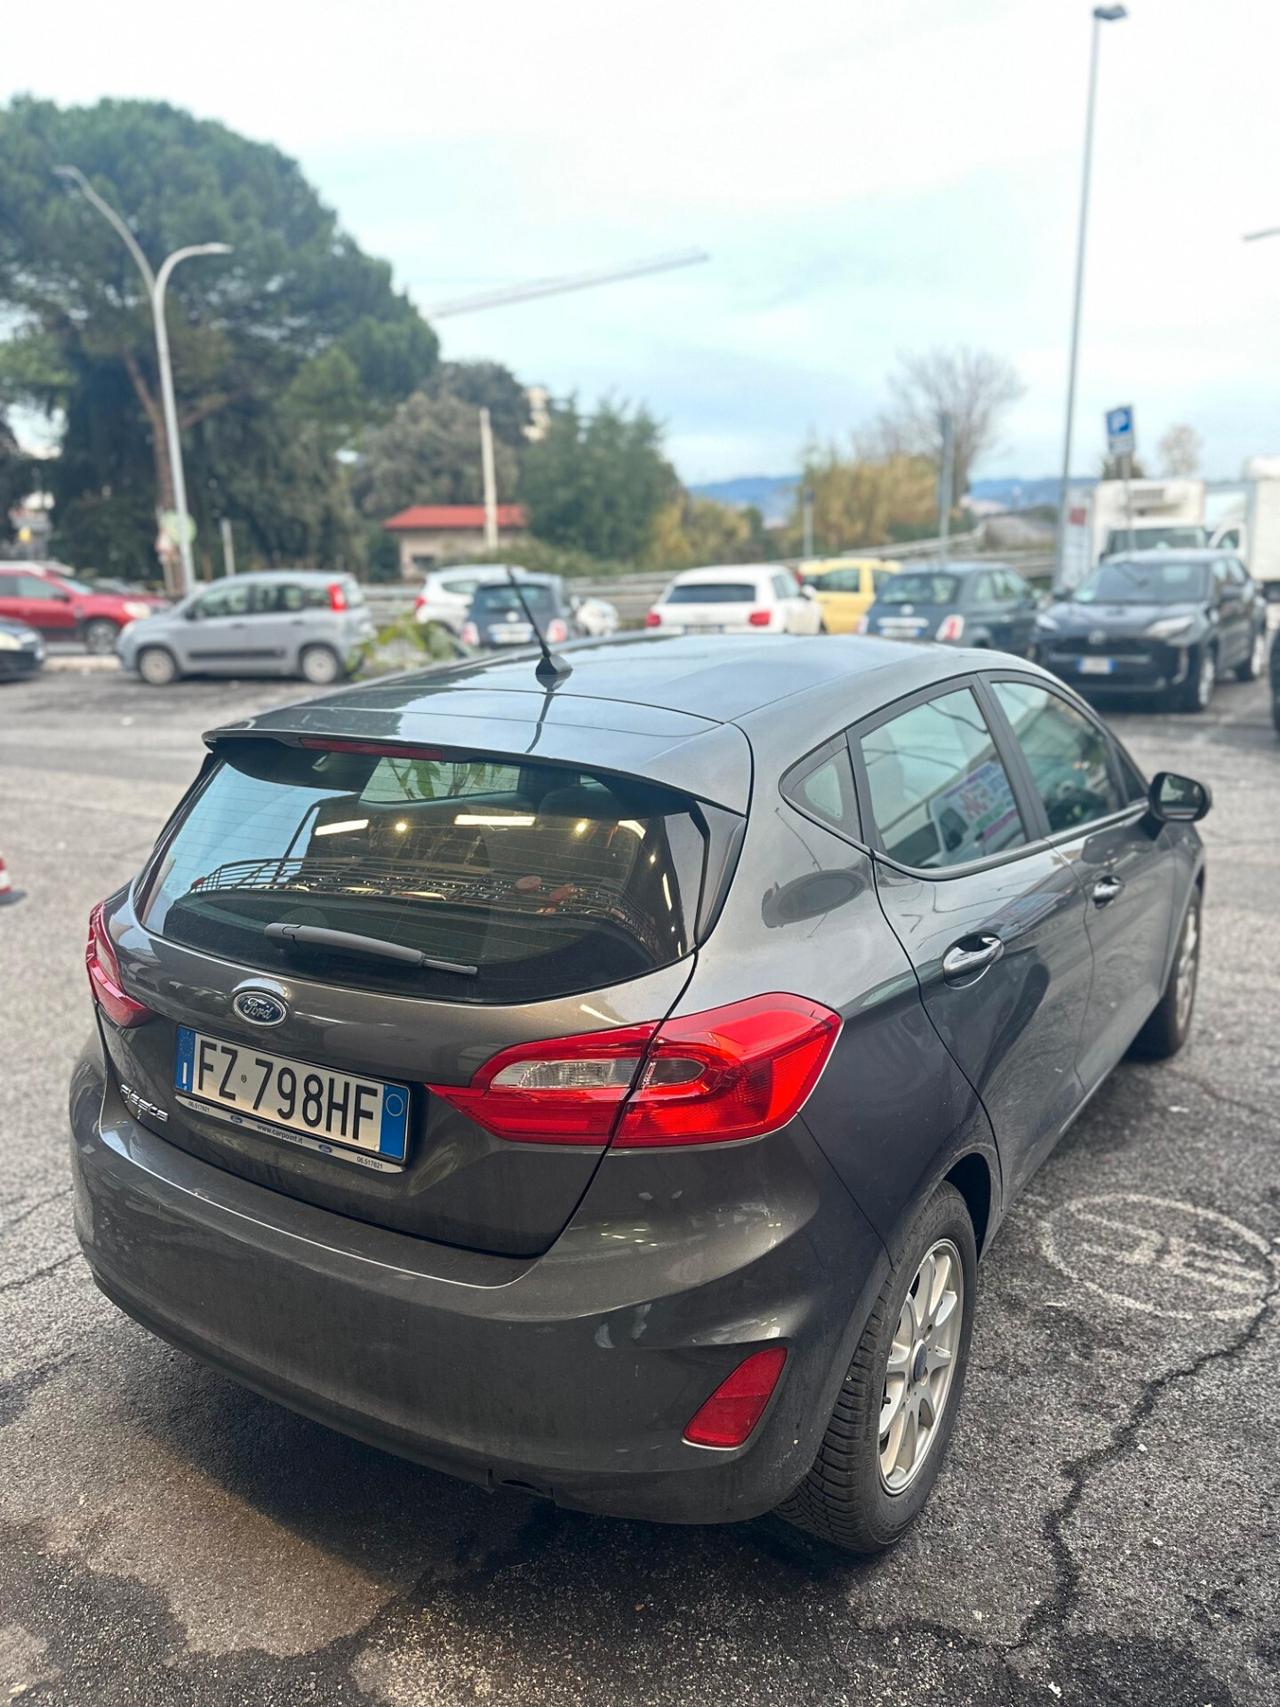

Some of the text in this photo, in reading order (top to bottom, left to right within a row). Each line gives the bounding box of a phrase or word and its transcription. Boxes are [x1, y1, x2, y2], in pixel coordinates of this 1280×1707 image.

[243, 996, 275, 1020] Ford
[198, 1039, 379, 1141] FZ 798HF
[256, 1124, 304, 1145] www.carpoint.it
